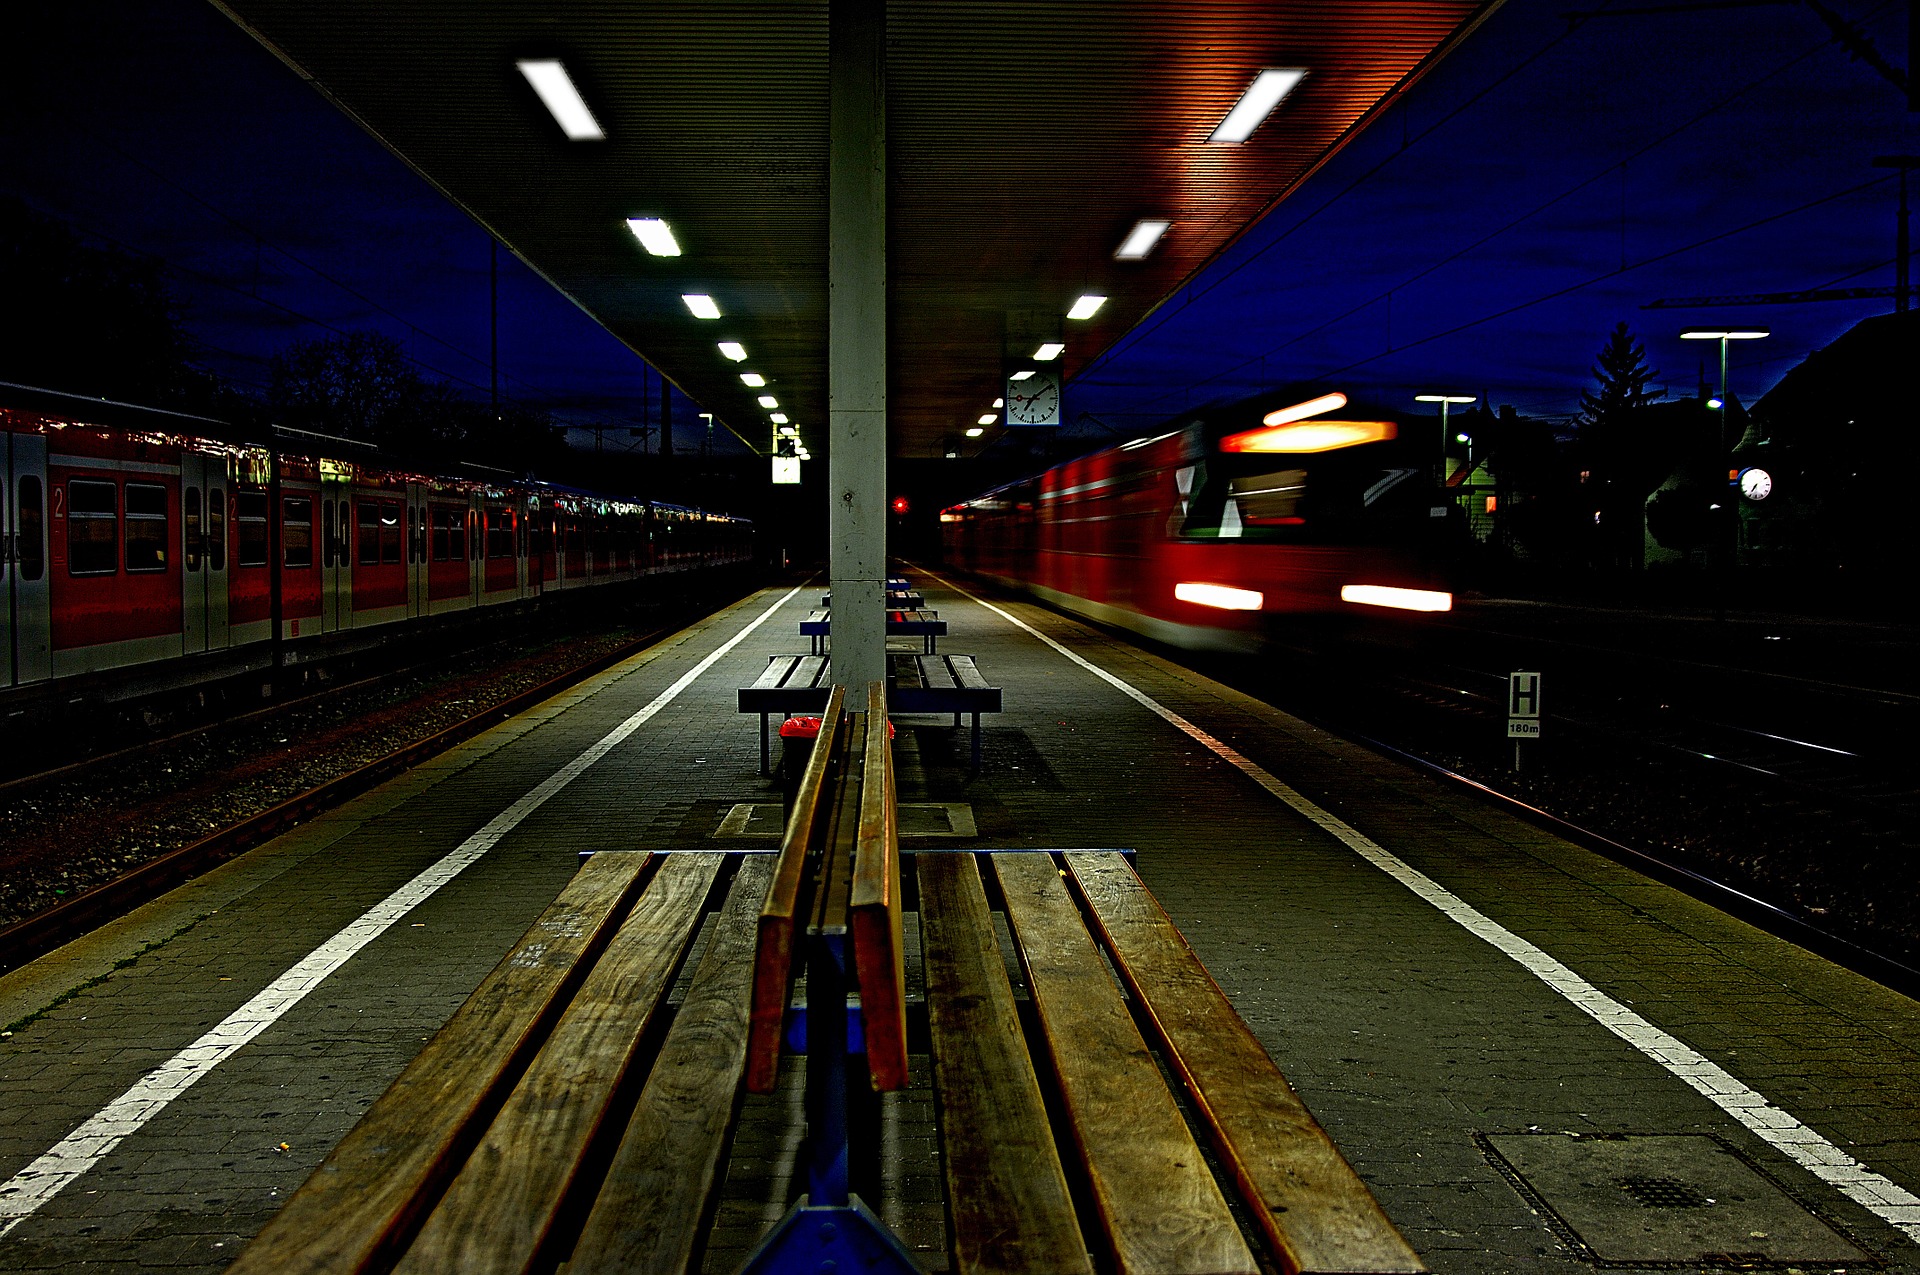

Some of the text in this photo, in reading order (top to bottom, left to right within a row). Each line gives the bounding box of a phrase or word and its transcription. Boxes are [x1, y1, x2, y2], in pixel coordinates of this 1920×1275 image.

[55, 487, 63, 518] 2
[230, 496, 237, 521] 2
[1513, 675, 1537, 714] H
[1510, 724, 1539, 733] 180m
